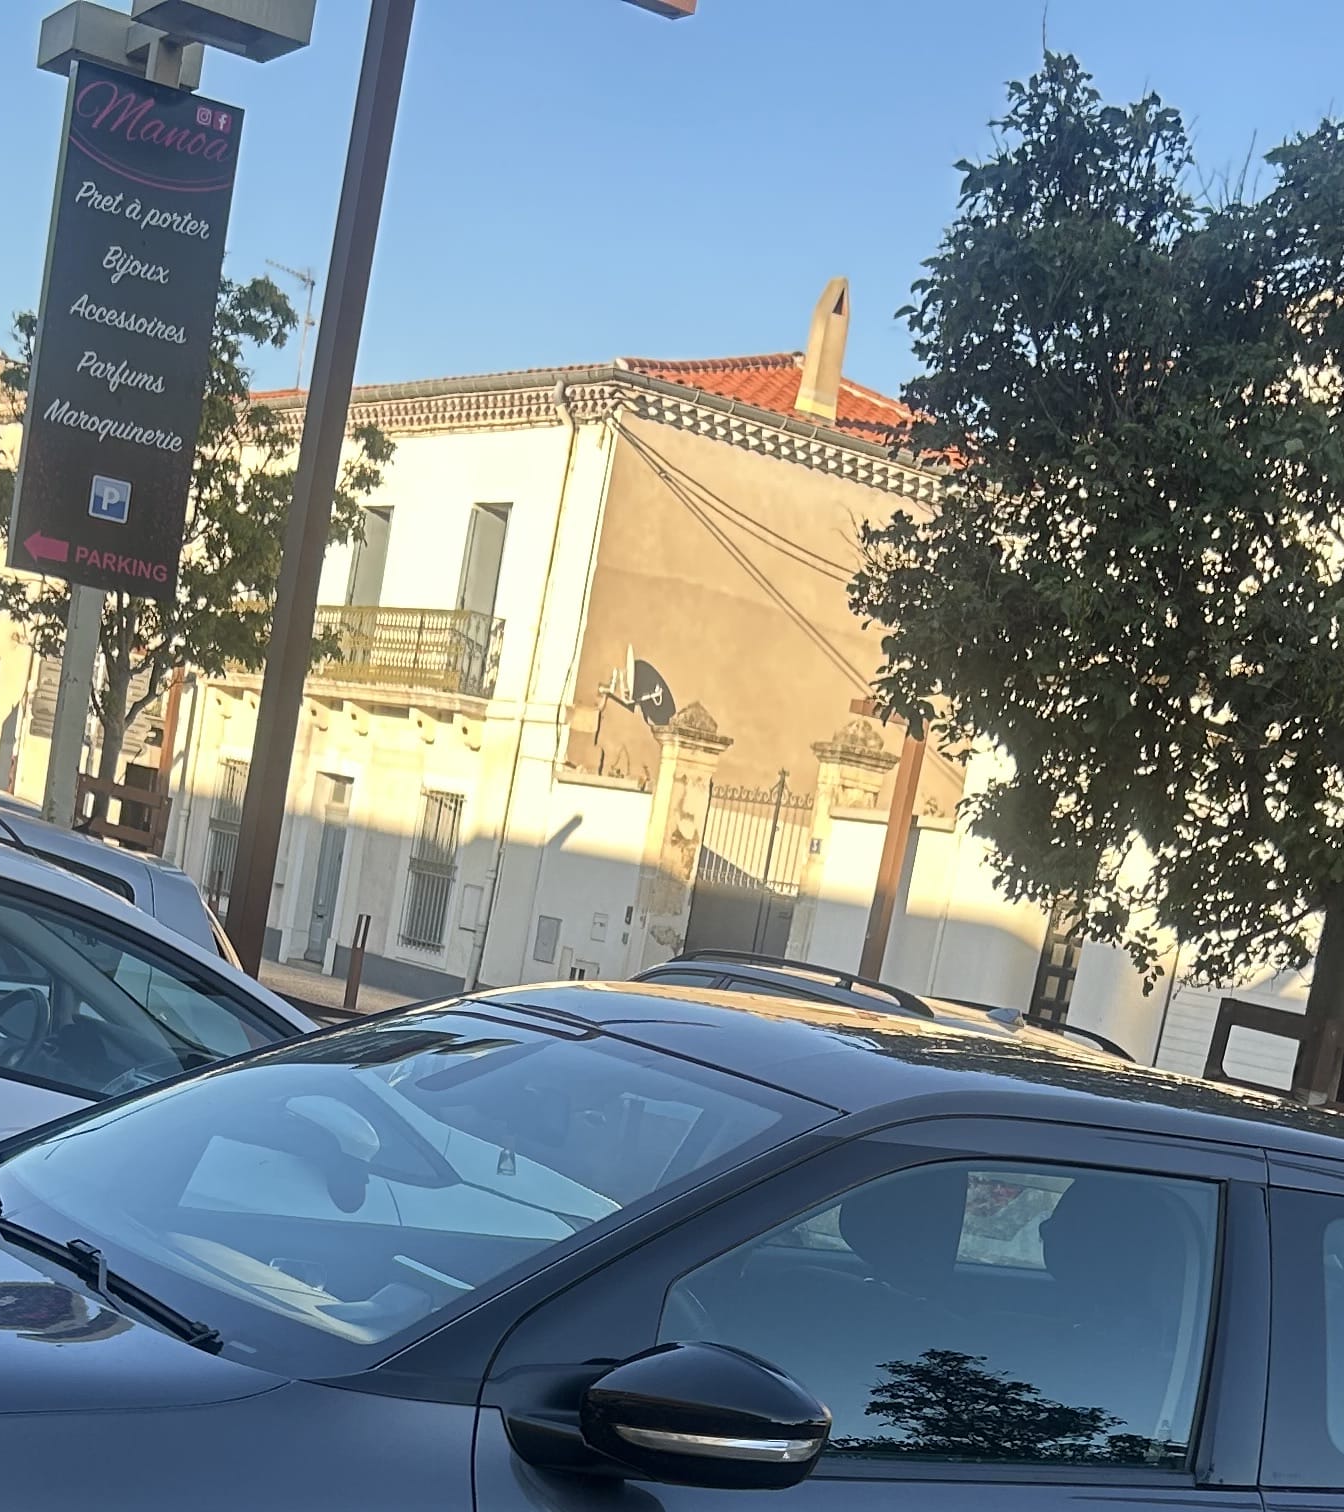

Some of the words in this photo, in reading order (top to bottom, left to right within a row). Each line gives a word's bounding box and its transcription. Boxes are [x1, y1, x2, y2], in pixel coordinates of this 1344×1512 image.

[76, 80, 229, 162] Manoa
[75, 181, 122, 215] Pret
[125, 198, 142, 221] à
[141, 208, 210, 239] porter
[102, 245, 170, 284] Bijoux
[69, 293, 187, 344] Accessoires
[76, 350, 166, 393] Parfums
[43, 400, 184, 453] Maroquinerie
[75, 546, 169, 583] PARKING
